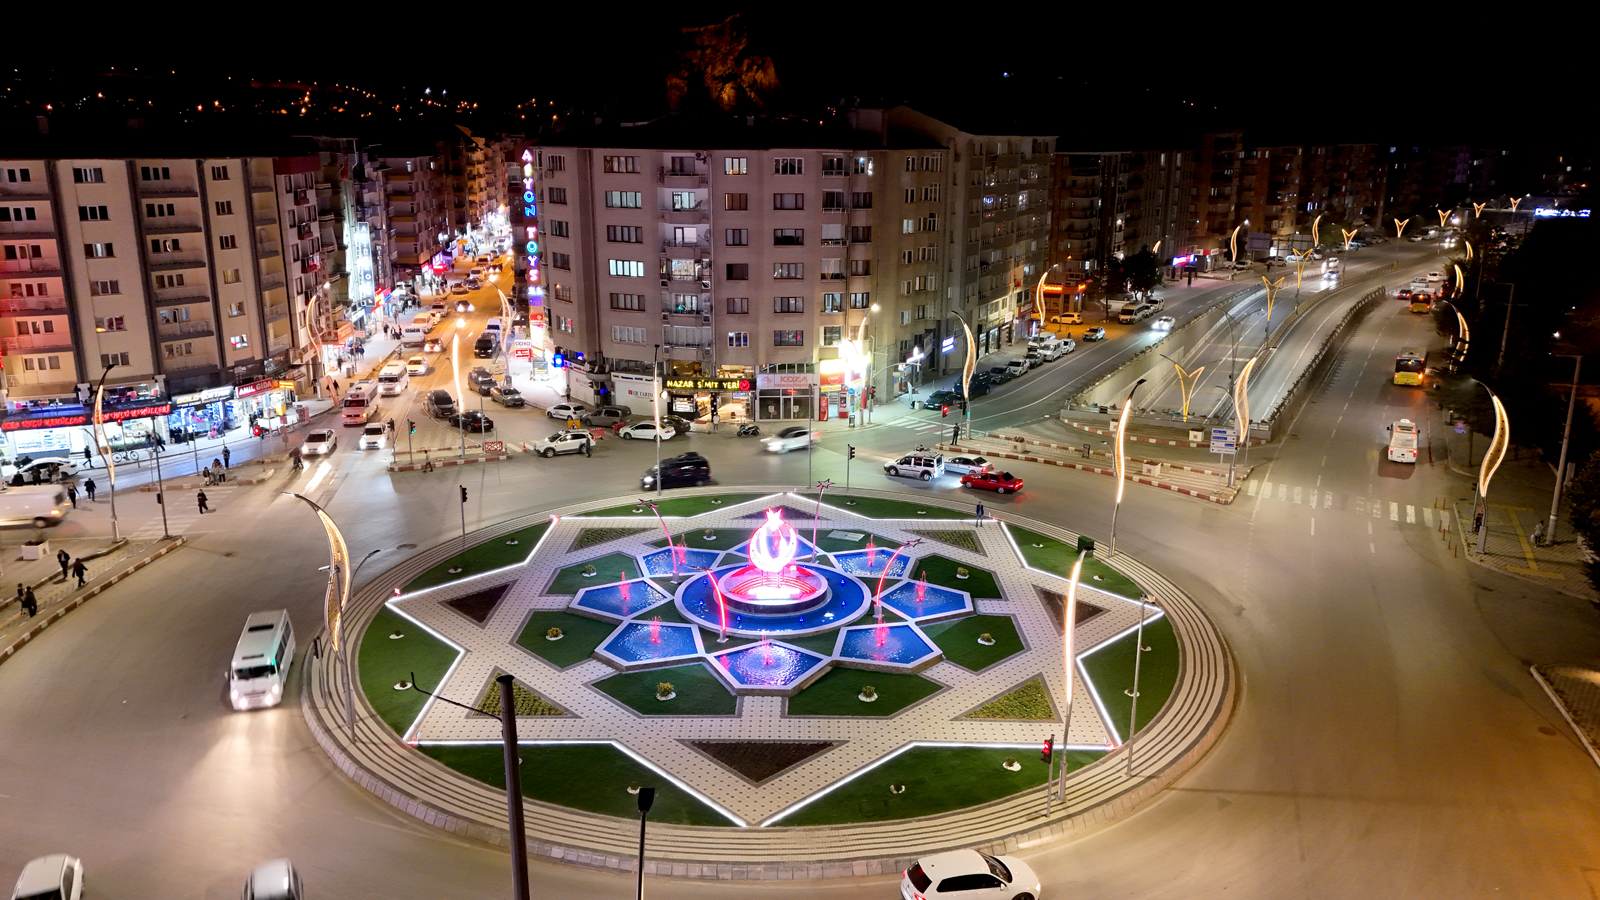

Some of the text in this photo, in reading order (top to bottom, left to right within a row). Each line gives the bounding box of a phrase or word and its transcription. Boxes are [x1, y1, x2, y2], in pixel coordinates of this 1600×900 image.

[521, 149, 537, 217] AFYON
[526, 226, 539, 281] TOYS
[256, 380, 272, 390] GIDA
[666, 380, 694, 388] NAZAR
[722, 380, 740, 389] YERİ
